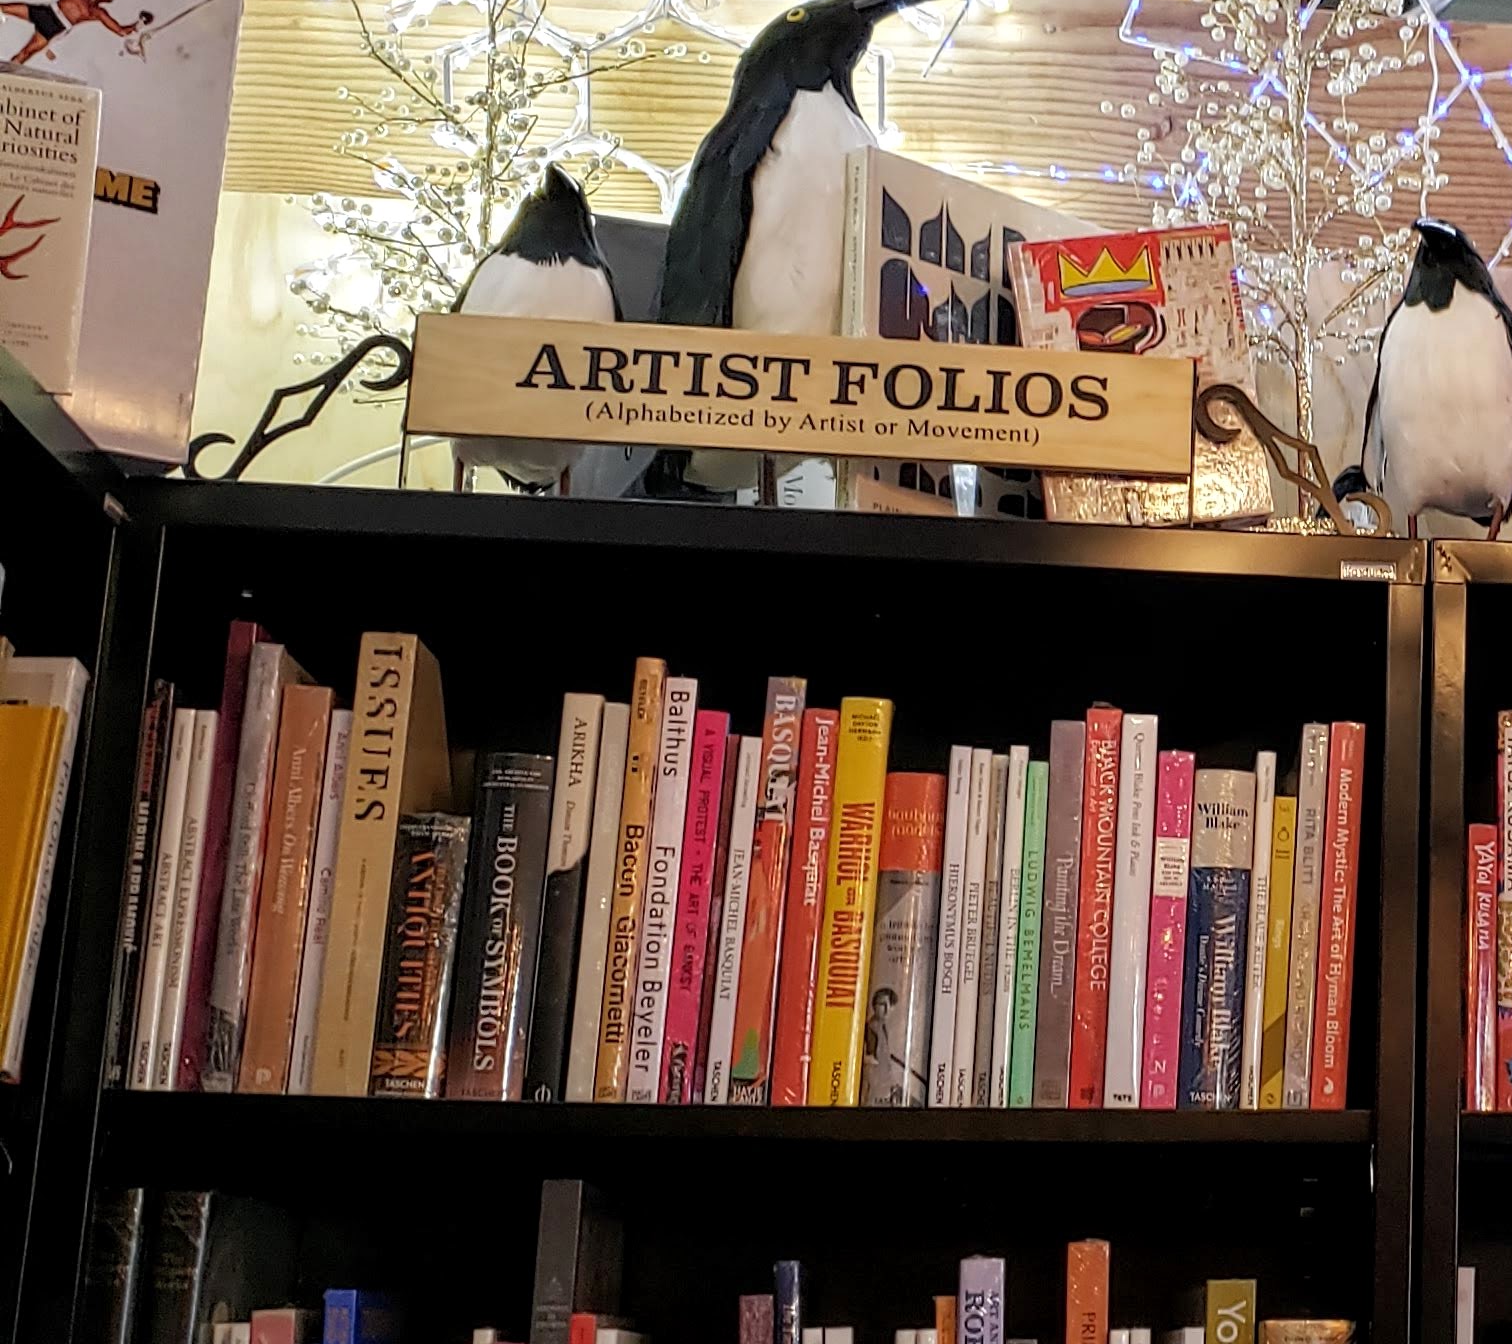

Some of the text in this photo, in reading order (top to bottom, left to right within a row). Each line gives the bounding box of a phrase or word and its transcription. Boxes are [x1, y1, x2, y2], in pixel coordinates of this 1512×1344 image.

[0, 97, 85, 126] binet of
[4, 119, 79, 146] Natural
[516, 344, 1110, 421] ARTIST FOLIOS
[586, 400, 1041, 447] (Alphabetized by Artist or Movement)
[354, 646, 404, 822] ISSUES
[566, 716, 589, 788] ARIKHA
[802, 716, 833, 908] Jean-Michel Basquiat
[473, 804, 518, 1072] THE BOOK SYMBOLS
[602, 824, 644, 1046] Bacon Giacometti
[632, 690, 689, 1073] Balthus Fondation Beyeler
[824, 801, 876, 1010] WARHOL BASQUIAT
[941, 863, 960, 995] HIERONYMUS BOSCH
[1017, 849, 1041, 1031] LUDWIG BEMELMANS
[1089, 909, 1108, 991] COLLEGE
[1323, 767, 1352, 1069] Modern Mystic: The Art of Hyman Bloom
